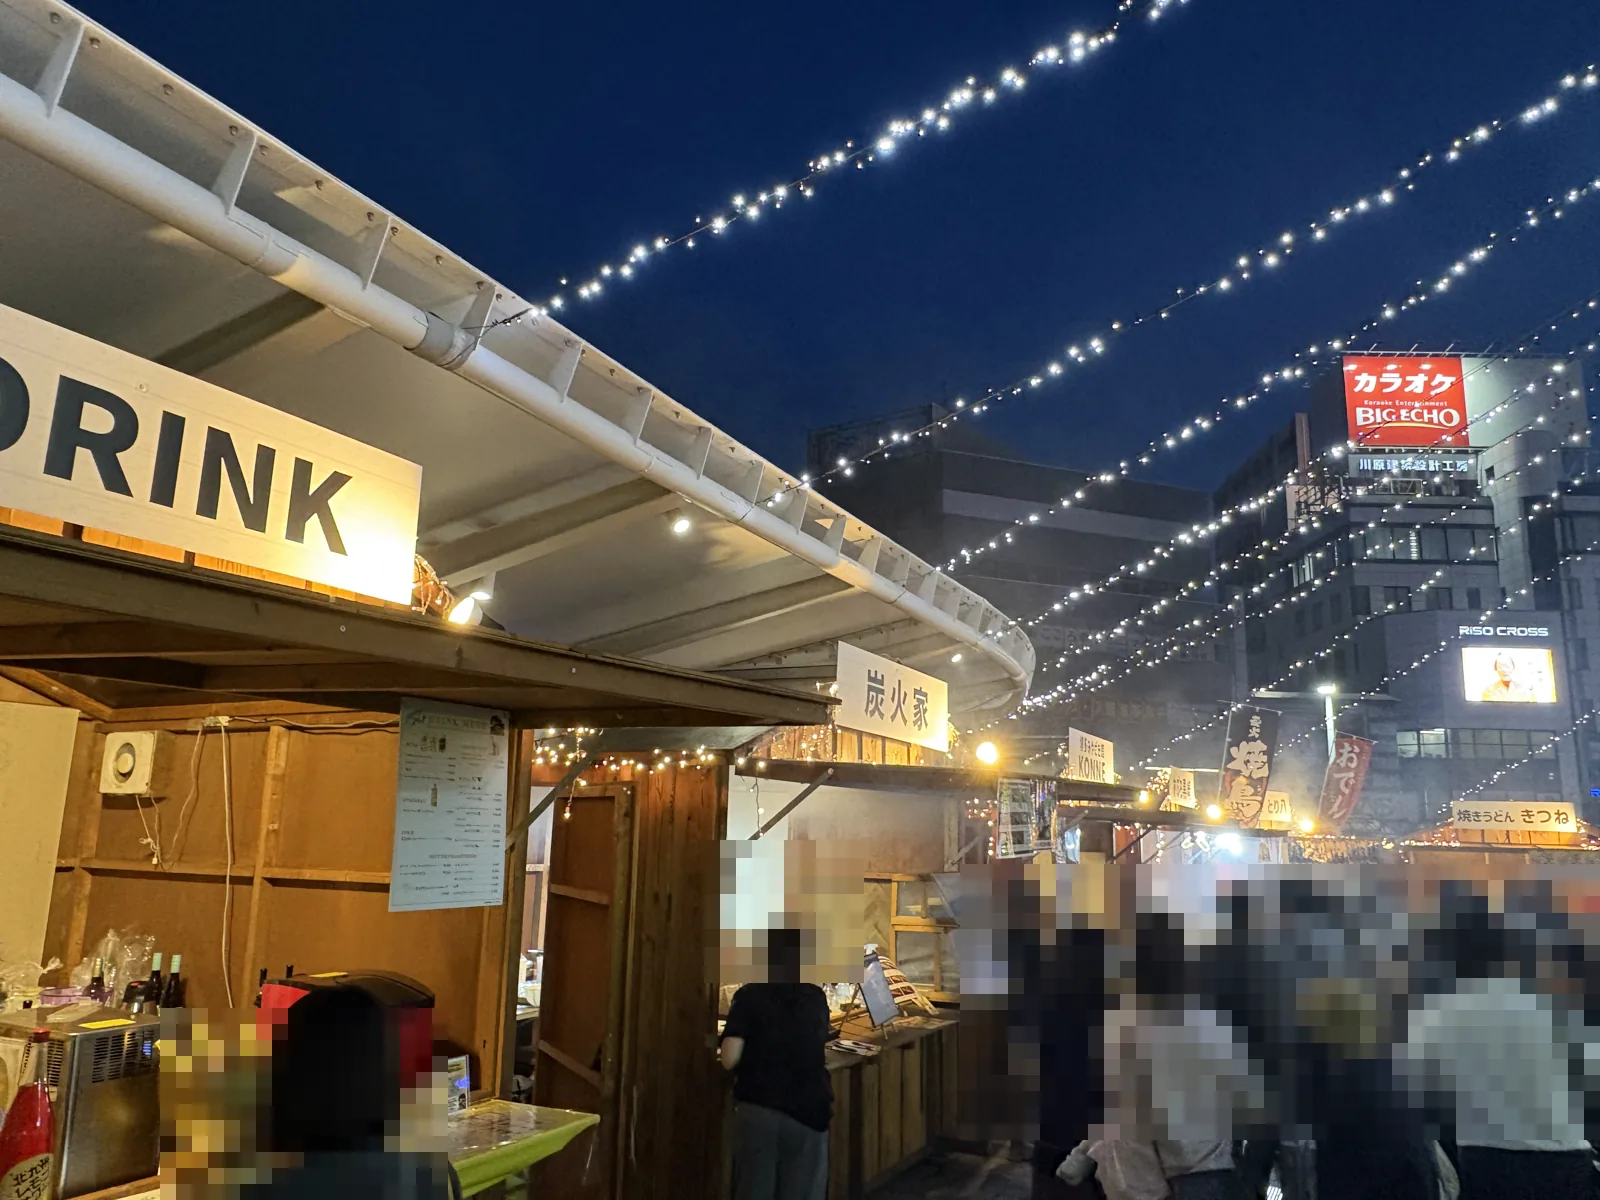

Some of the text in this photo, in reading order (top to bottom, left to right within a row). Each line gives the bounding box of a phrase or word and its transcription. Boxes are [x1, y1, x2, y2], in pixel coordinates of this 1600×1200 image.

[1354, 373, 1456, 395] カラオケ
[1356, 407, 1460, 427] BIG ECHO
[1496, 627, 1549, 637] CROSS
[864, 668, 929, 732] 炭火家
[1078, 755, 1106, 783] KONNE
[1329, 742, 1360, 819] おでん
[1457, 808, 1570, 825] 焼きうどん きつね
